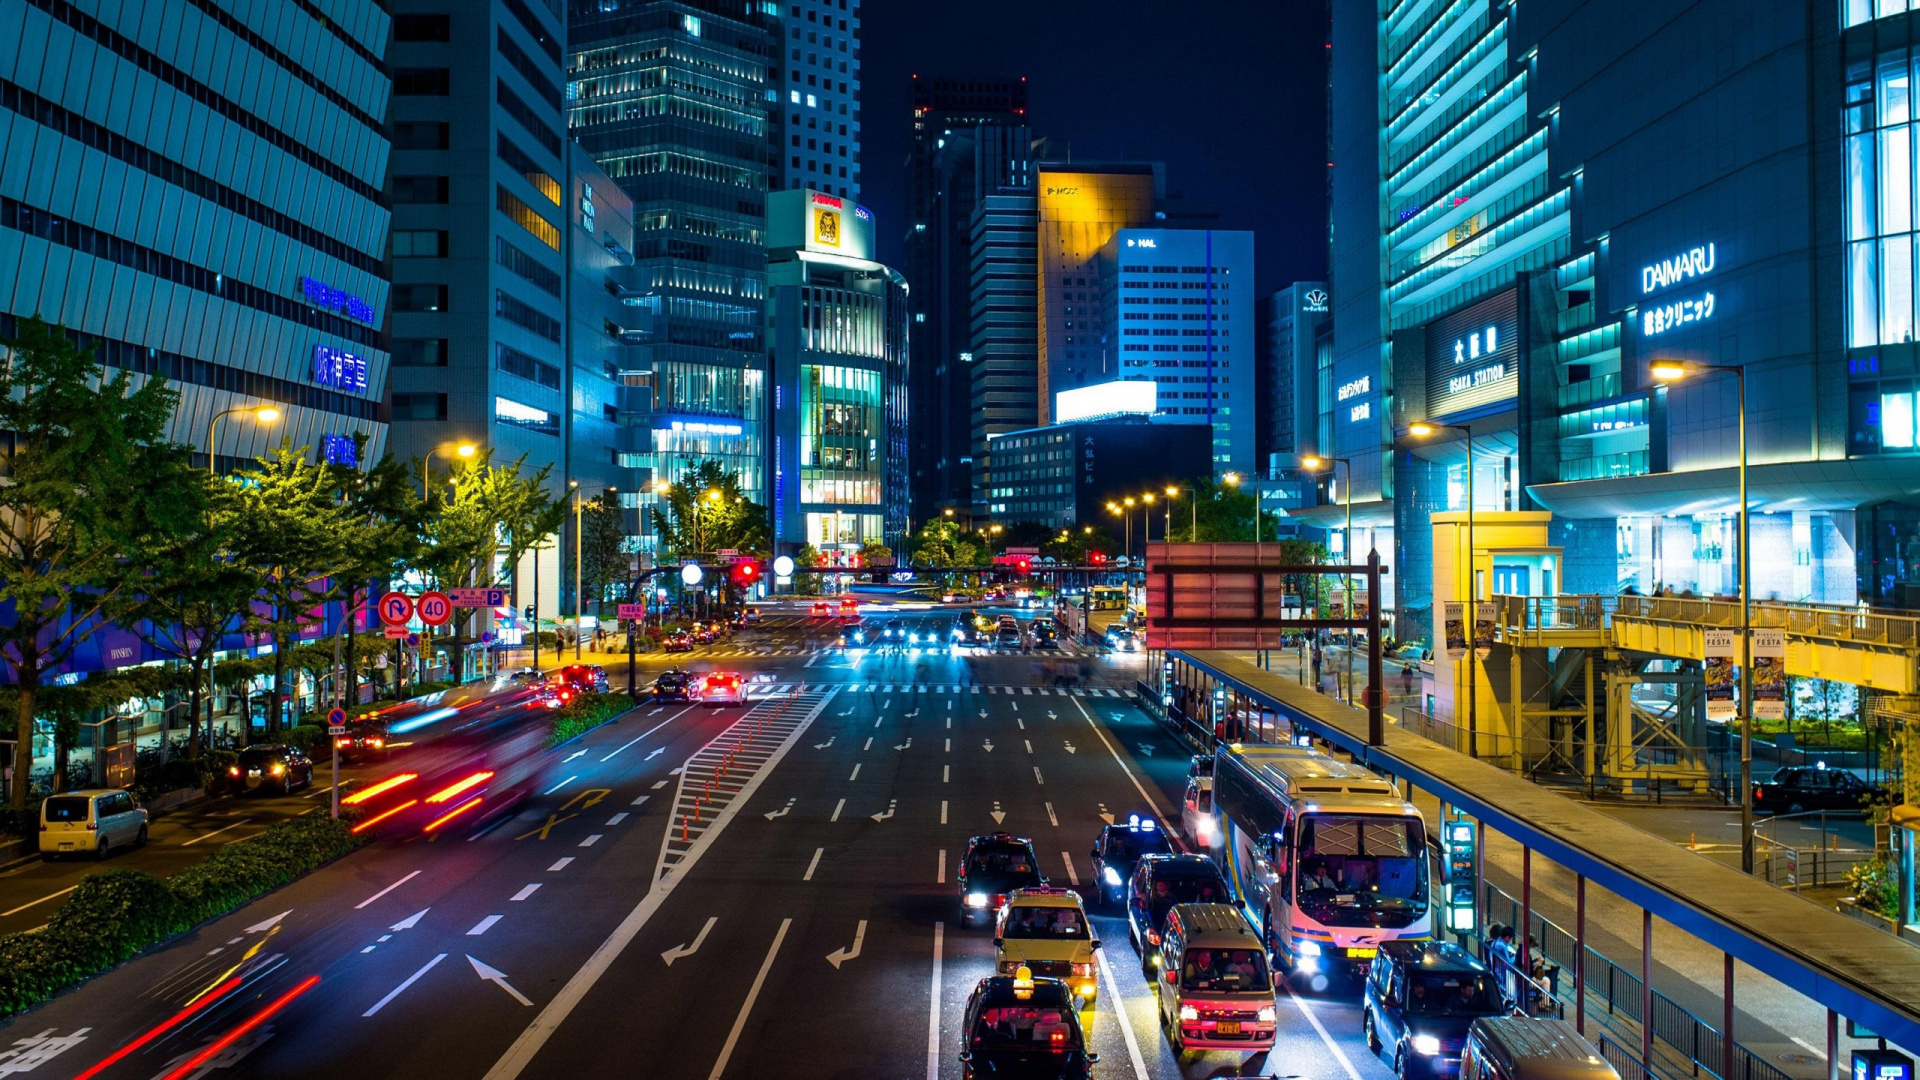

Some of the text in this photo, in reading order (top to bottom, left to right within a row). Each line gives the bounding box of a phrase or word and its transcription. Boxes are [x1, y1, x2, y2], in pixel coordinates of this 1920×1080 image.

[1137, 239, 1157, 248] HAL
[1642, 242, 1715, 294] DAIMARU
[1643, 291, 1715, 336] 総合クリニック
[1449, 364, 1504, 394] OSAKA STATION
[491, 592, 500, 604] P
[425, 601, 444, 617] 40
[110, 646, 133, 660] HANSHIN
